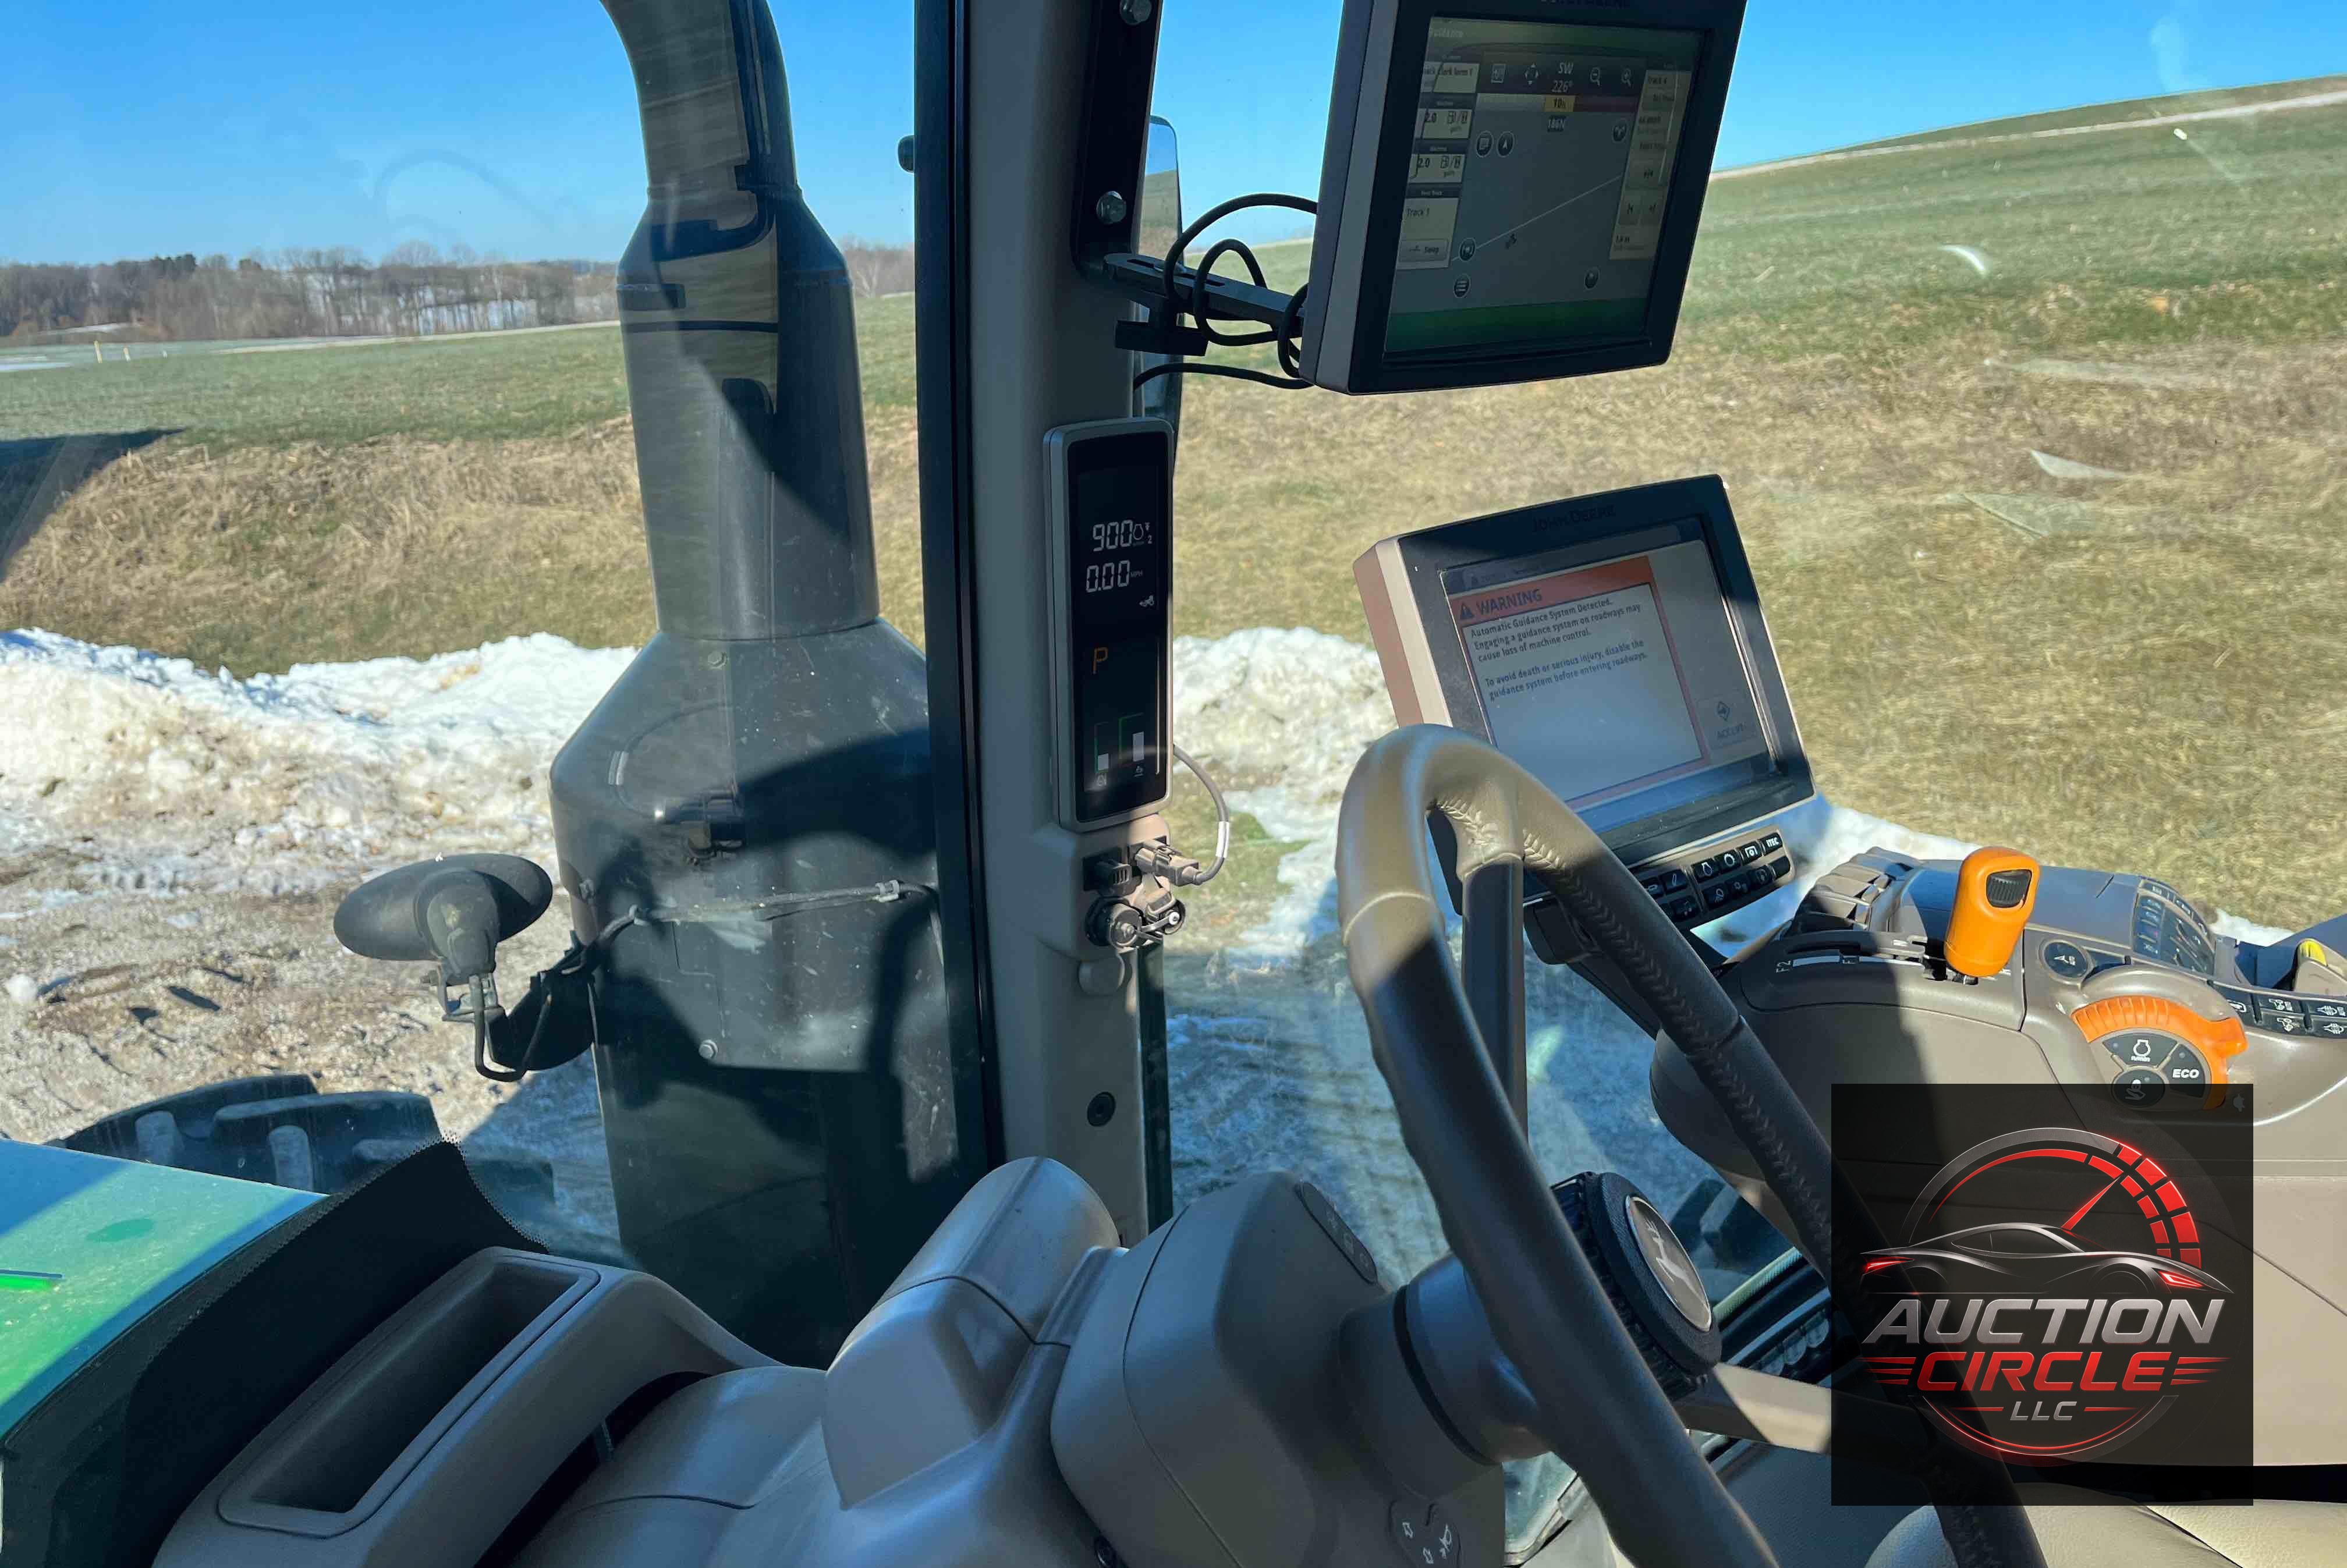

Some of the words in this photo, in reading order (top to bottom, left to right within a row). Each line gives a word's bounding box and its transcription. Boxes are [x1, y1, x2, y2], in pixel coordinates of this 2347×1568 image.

[1558, 62, 1574, 75] SW
[1093, 520, 1133, 551] 900
[1086, 560, 1130, 593] 0.00
[1476, 588, 1541, 615] WARNING
[1472, 623, 1512, 638] Automatic
[1513, 615, 1548, 629] Guidance
[1549, 607, 1576, 621] System
[1577, 598, 1613, 612] Detected.
[1474, 634, 1510, 650] Engaging
[1518, 625, 1551, 642] guidance
[1552, 619, 1579, 633] system
[1591, 607, 1625, 621] roadways
[1626, 604, 1641, 613] may
[1092, 647, 1108, 675] P
[1479, 650, 1501, 662] cause
[1502, 646, 1518, 657] loss
[1519, 641, 1527, 652] of
[1529, 636, 1561, 650] machine
[1562, 628, 1591, 642] control.
[1486, 678, 1494, 686] To
[1496, 671, 1517, 684] avoid
[1518, 665, 1540, 677] death
[1542, 664, 1550, 672] or
[1552, 657, 1579, 669] serious
[1605, 643, 1630, 655] disable
[1631, 640, 1644, 649] the
[1490, 684, 1525, 702] guidance
[1526, 677, 1552, 691] system
[1554, 669, 1579, 682] before
[1580, 661, 1612, 674] entering
[1776, 960, 1791, 973] F2
[2172, 1069, 2199, 1078] ECO
